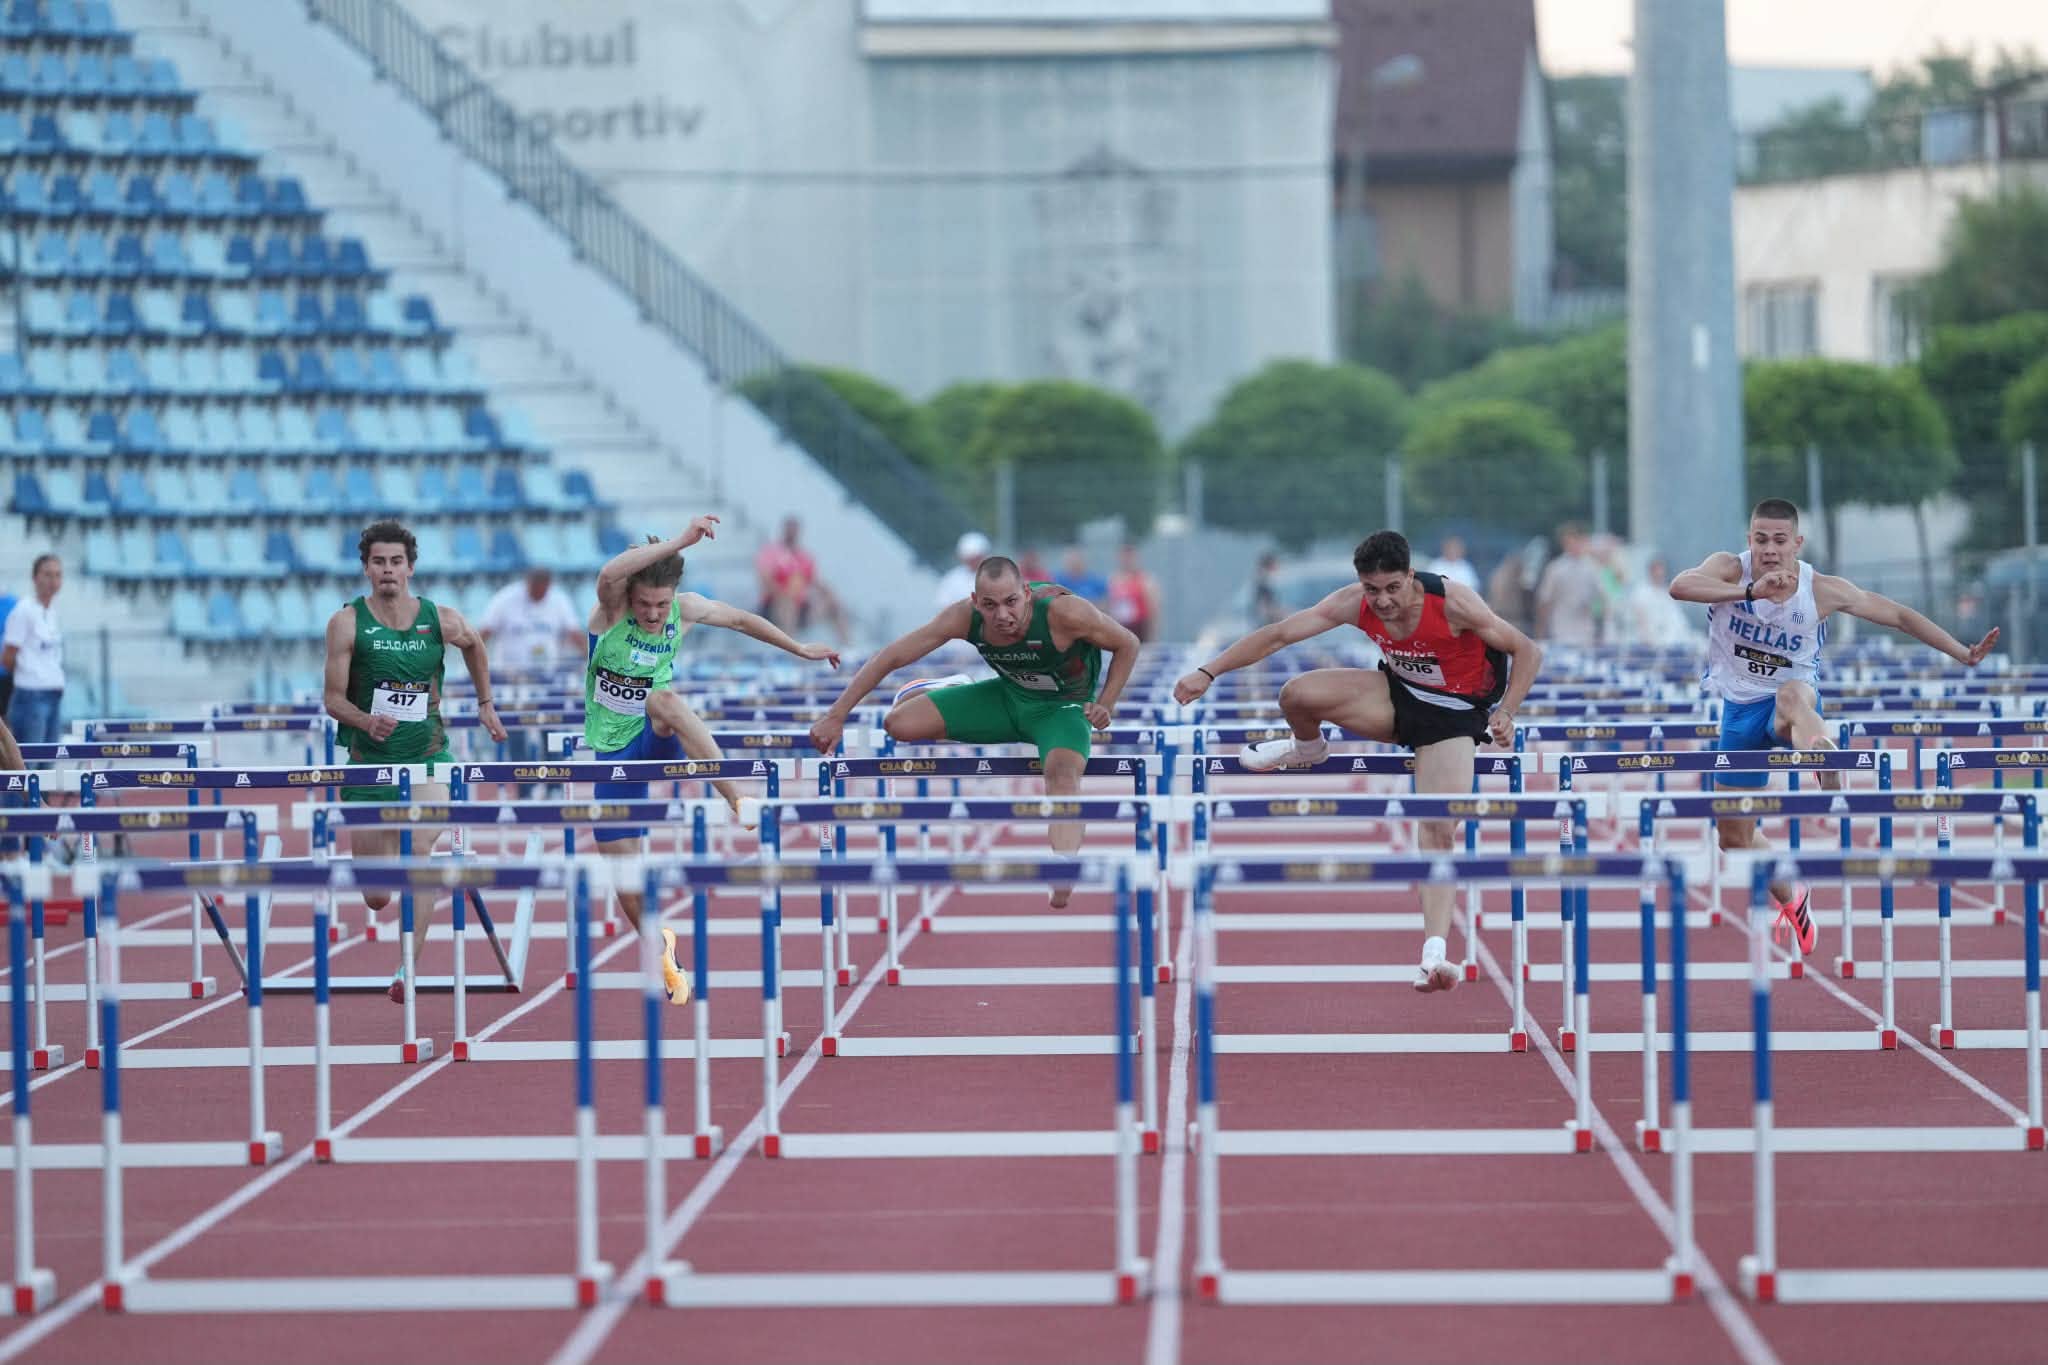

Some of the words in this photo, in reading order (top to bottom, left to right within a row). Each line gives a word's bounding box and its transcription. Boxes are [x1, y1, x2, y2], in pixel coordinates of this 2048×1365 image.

[1729, 615, 1802, 652] HELLAS
[373, 639, 427, 651] BULGARIA
[1748, 661, 1778, 677] 817
[599, 680, 648, 701] 6009
[387, 692, 417, 707] 417
